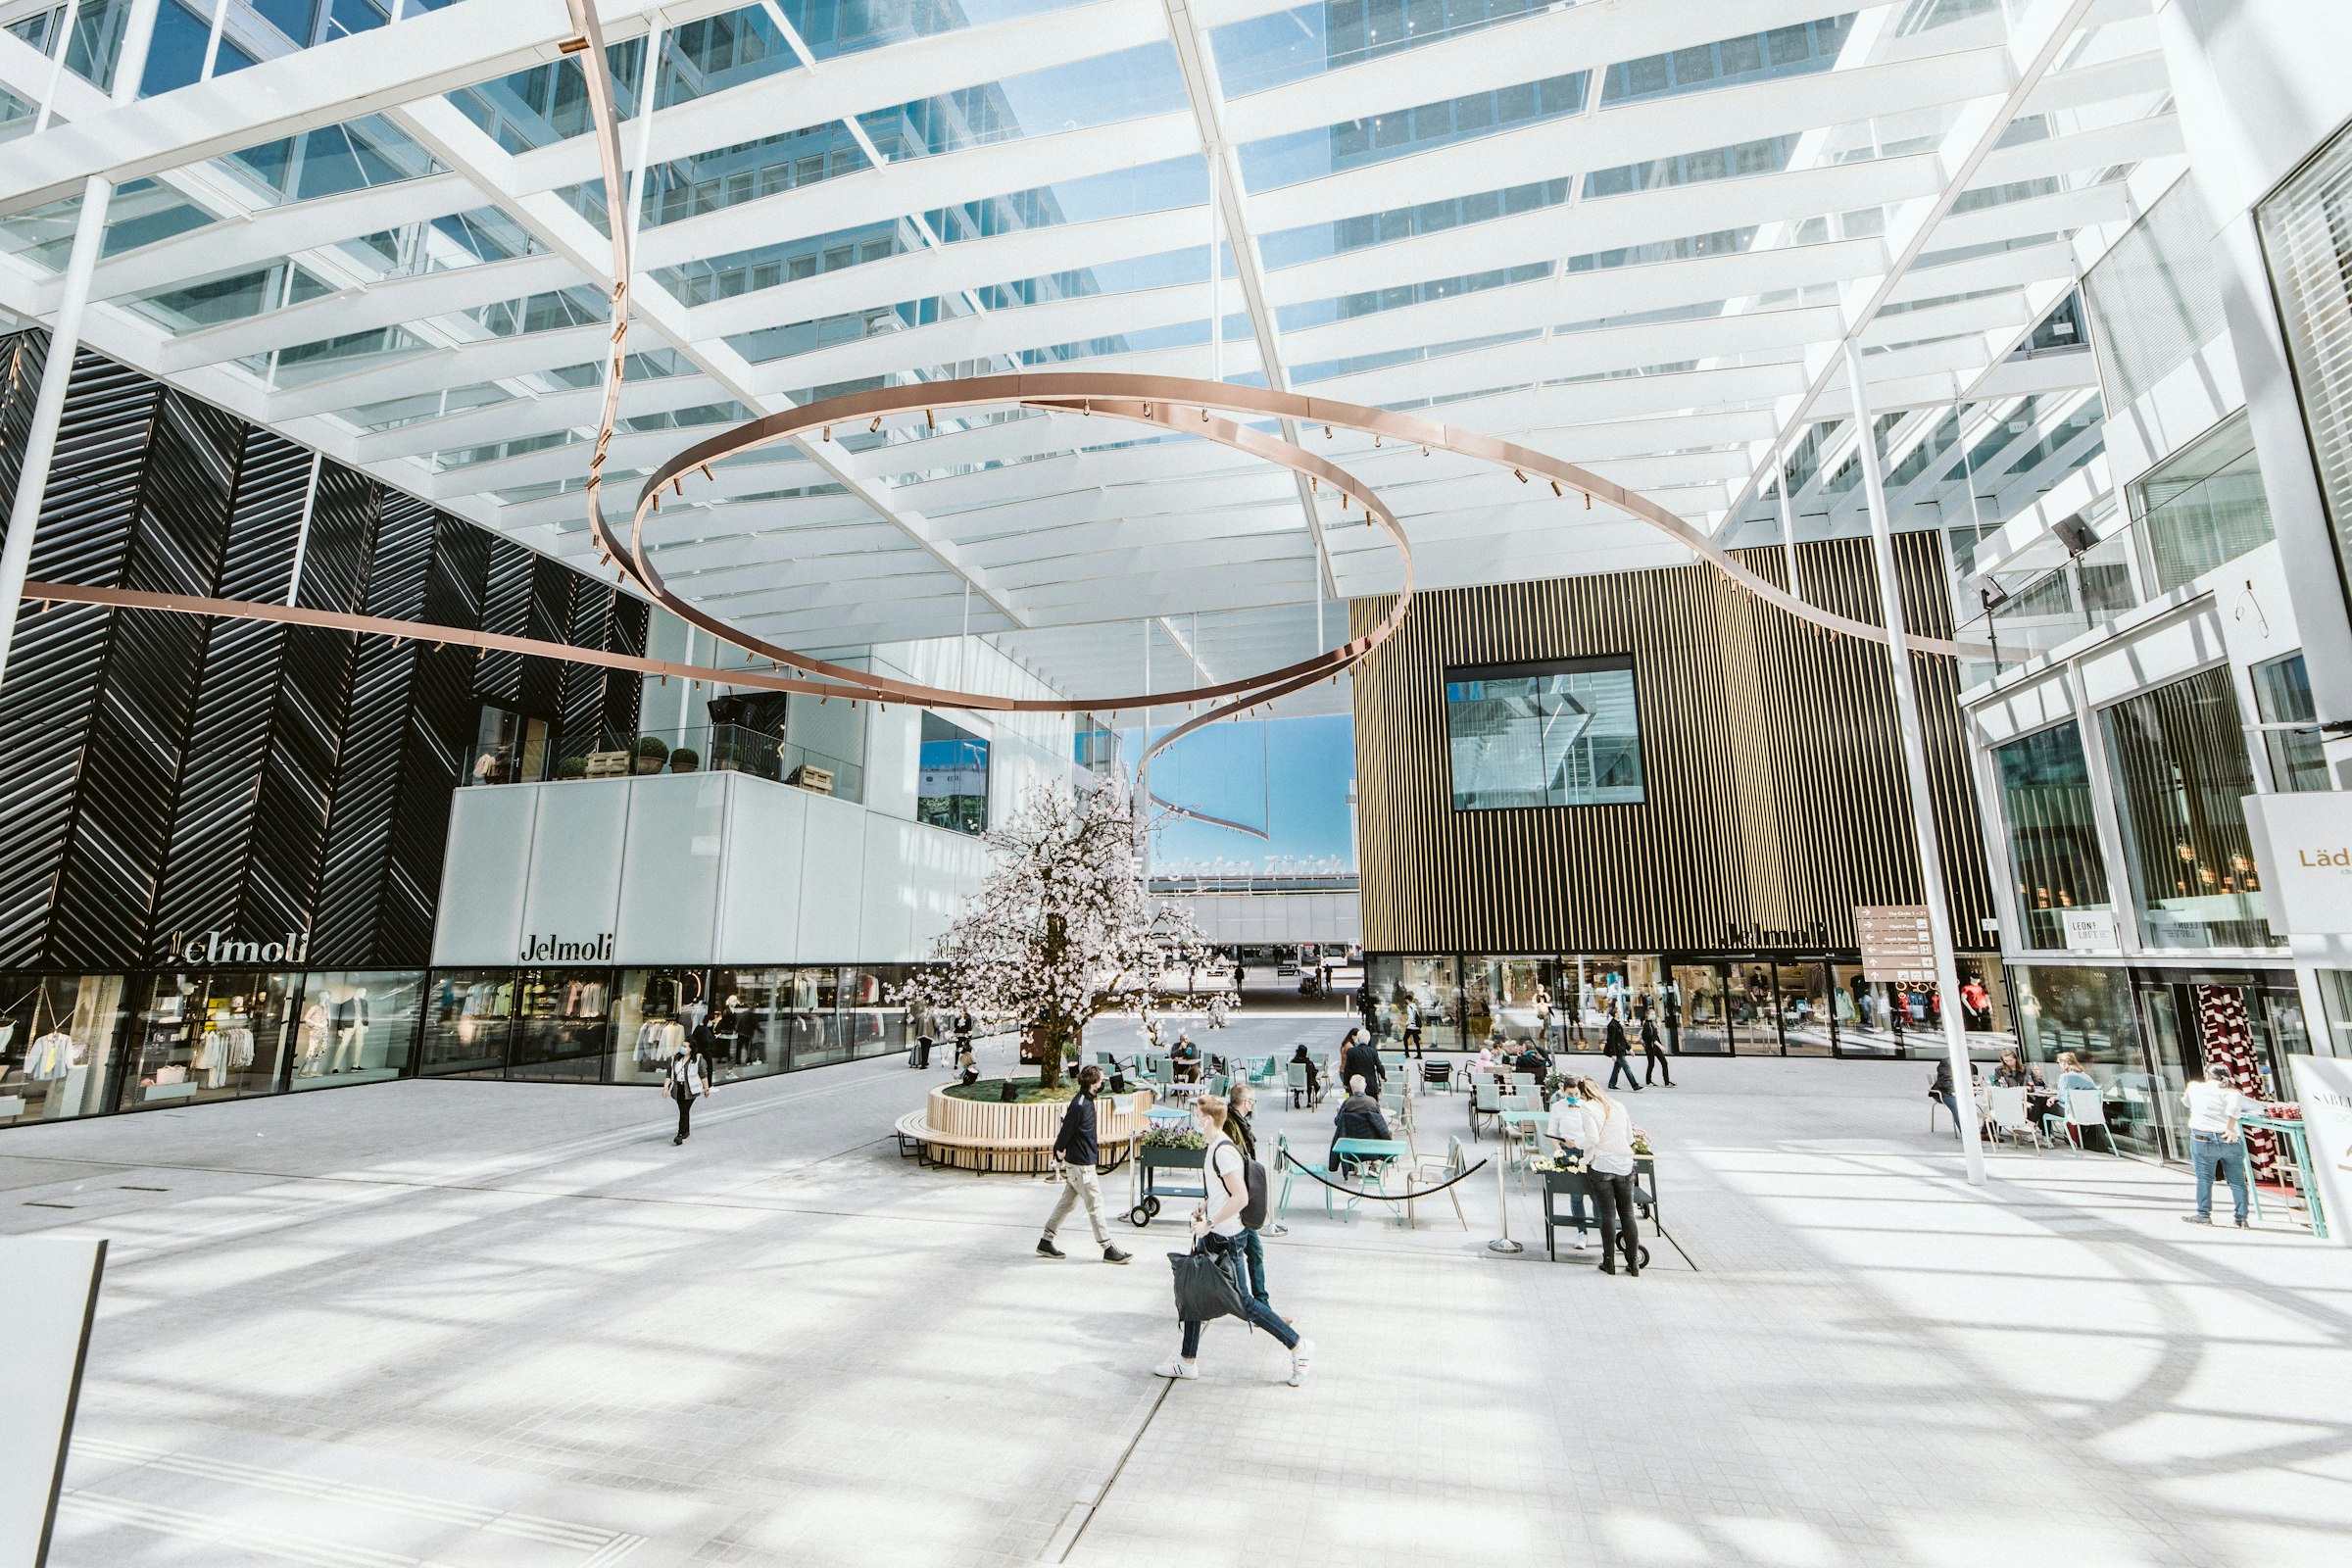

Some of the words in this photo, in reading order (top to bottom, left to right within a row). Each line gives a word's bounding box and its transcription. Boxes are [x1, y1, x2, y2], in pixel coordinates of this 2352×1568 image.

[1264, 855, 1347, 875] Zürich
[163, 930, 310, 964] Jelmoli
[520, 933, 613, 961] Jelmoli
